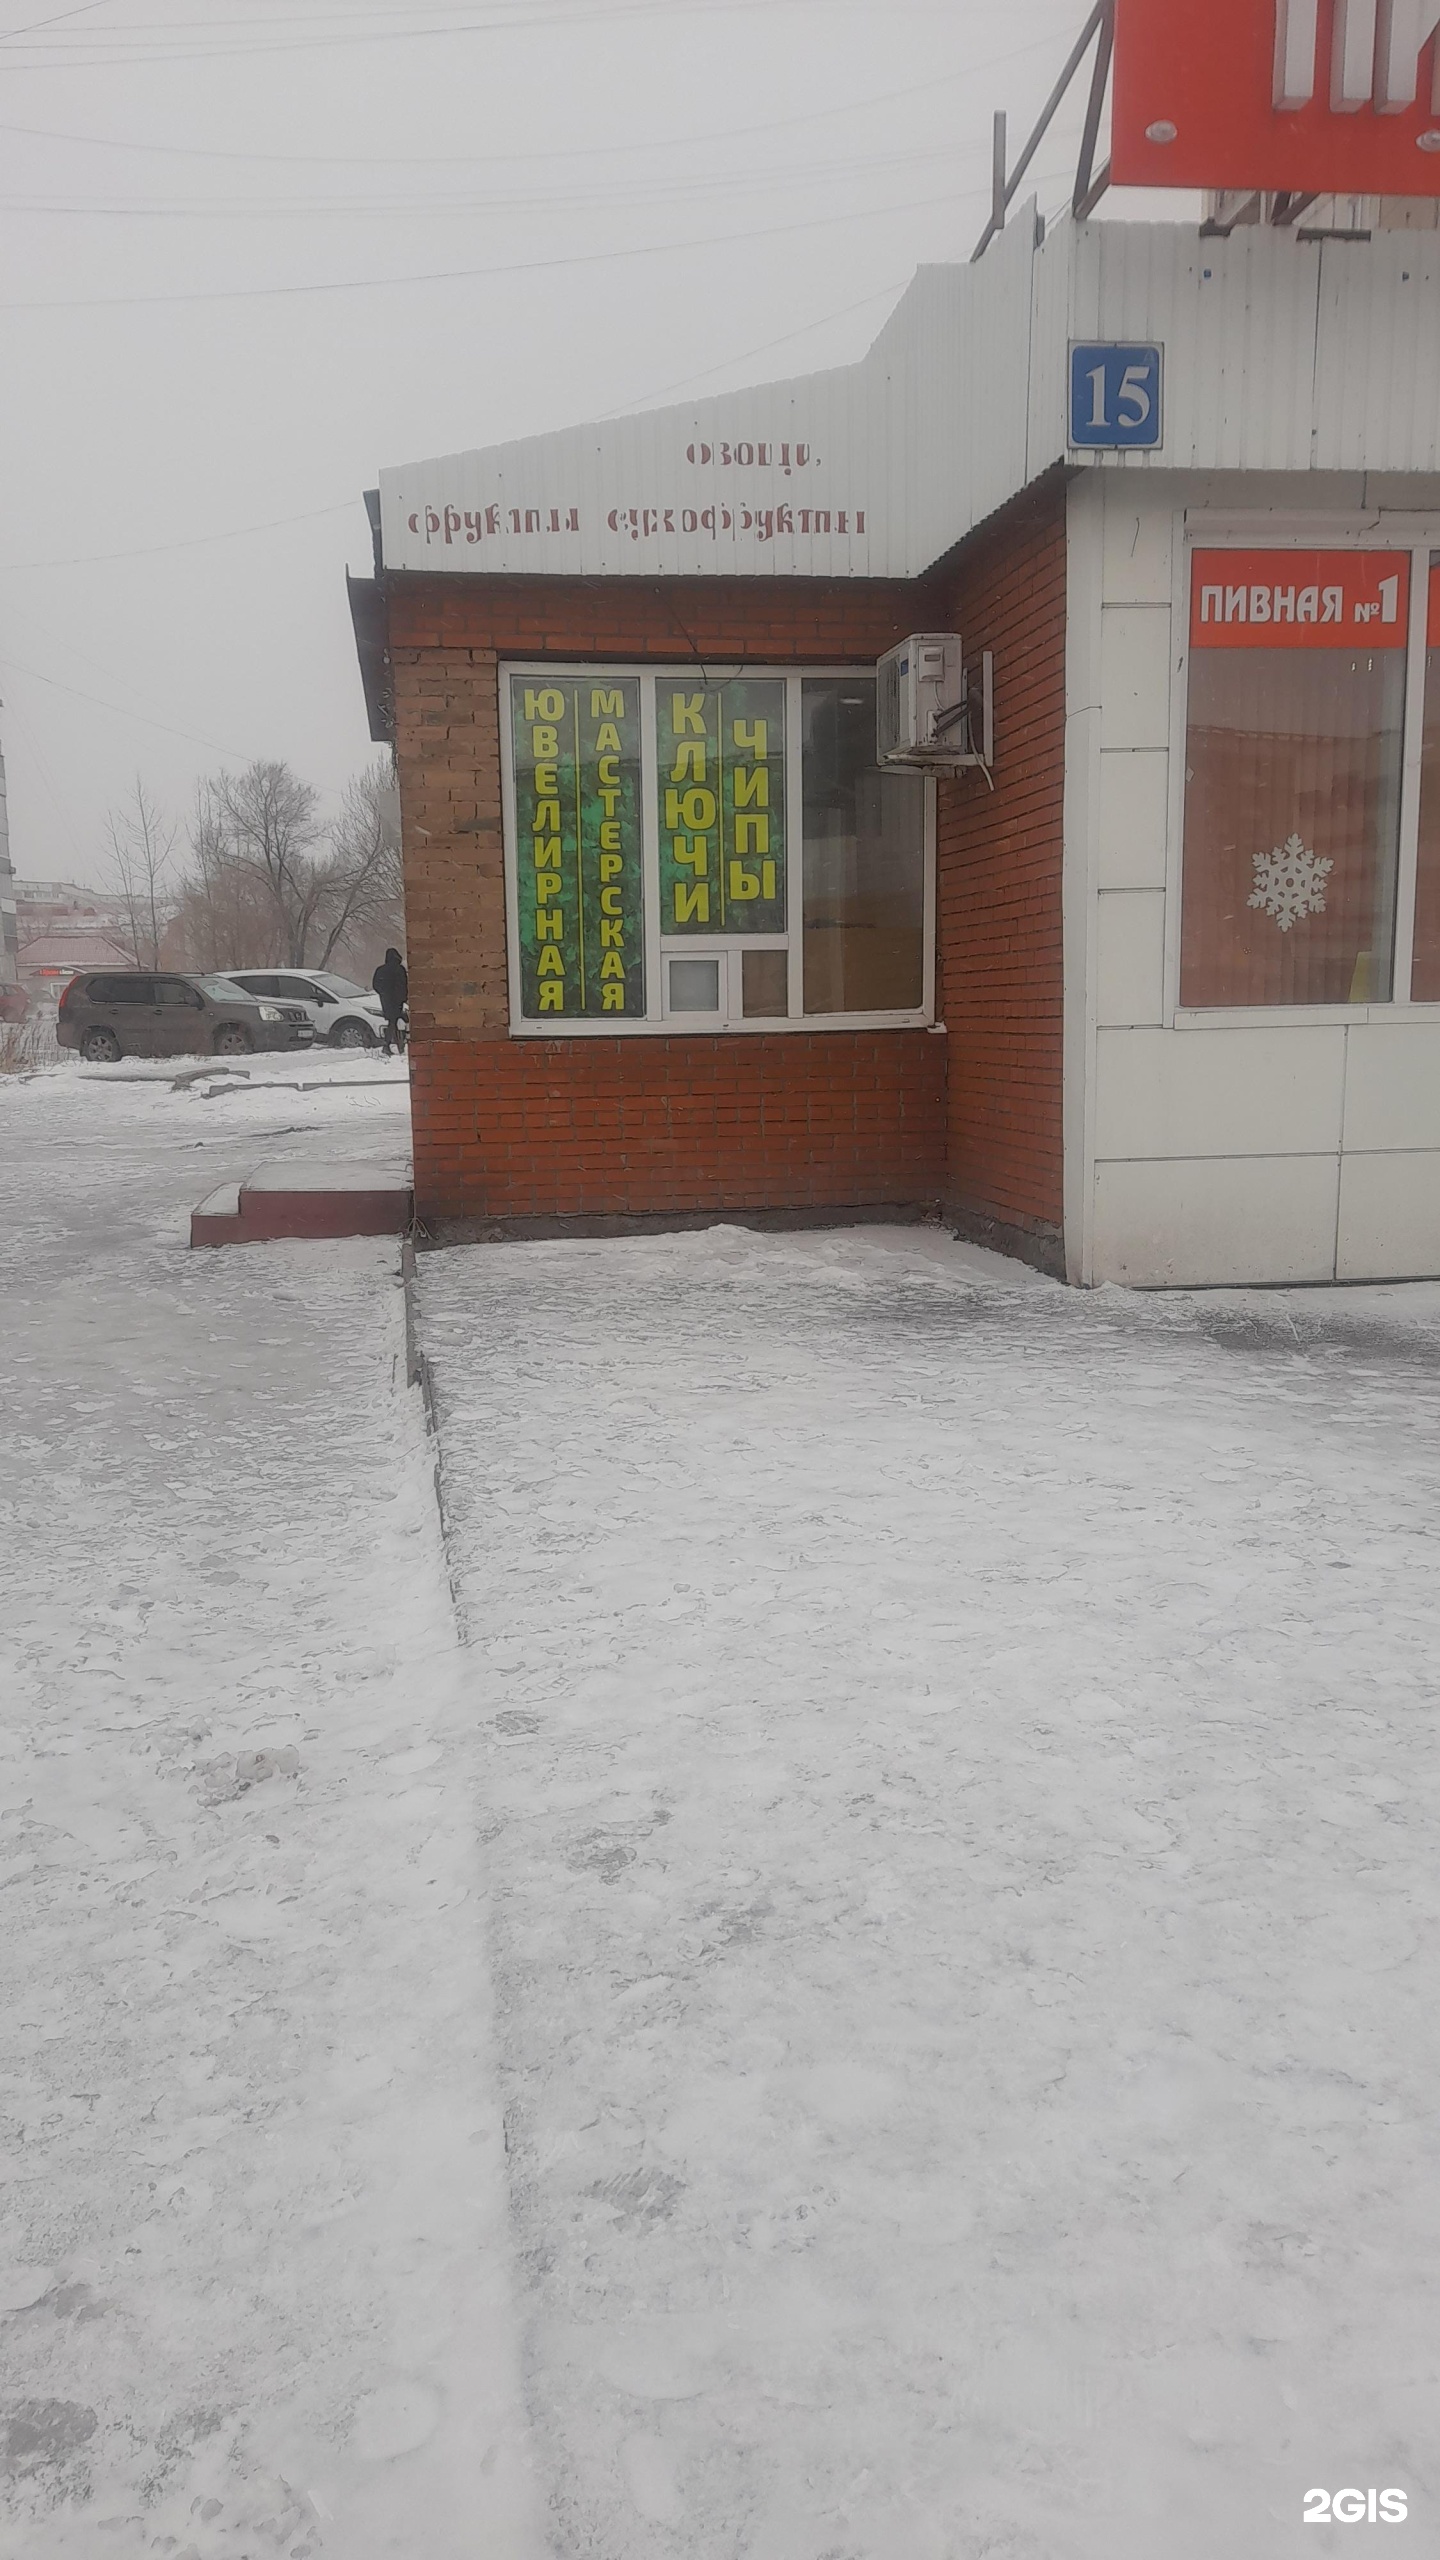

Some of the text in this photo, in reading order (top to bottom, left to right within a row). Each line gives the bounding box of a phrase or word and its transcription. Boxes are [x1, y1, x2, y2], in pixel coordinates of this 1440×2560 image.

[1085, 364, 1150, 427] 15
[1201, 585, 1343, 622] ПИВНАЯ
[523, 688, 566, 1011] ЮВЕЛИРНАЯ
[590, 689, 625, 1010] МАСТЕРСКАЯ
[664, 692, 717, 923] КЛЮЧИ
[728, 718, 777, 900] ЧИПЫ
